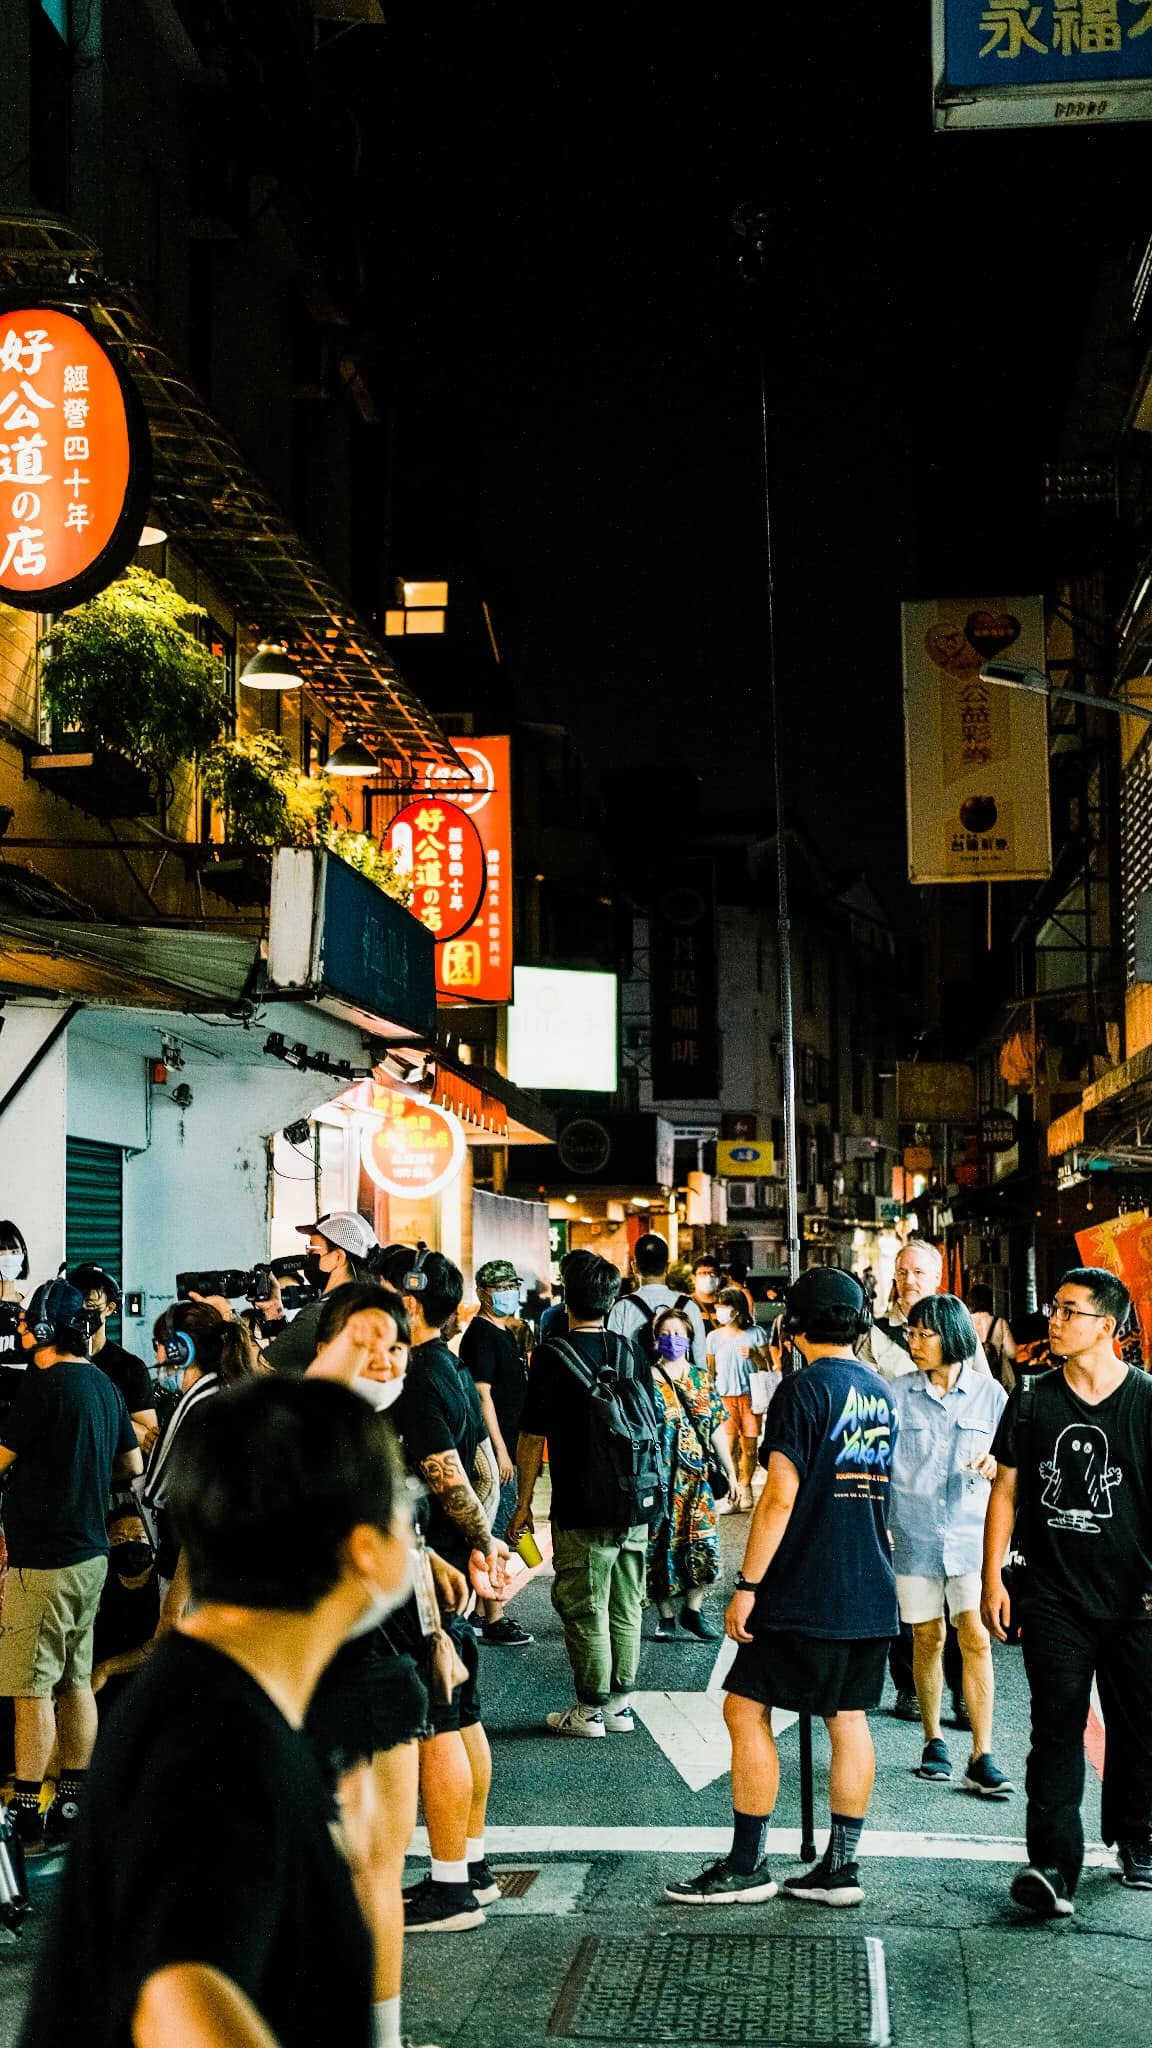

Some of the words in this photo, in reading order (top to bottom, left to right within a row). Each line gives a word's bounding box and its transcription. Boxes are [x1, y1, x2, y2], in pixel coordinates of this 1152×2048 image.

[63, 364, 91, 534] 經營四十年
[413, 807, 446, 933] 好公道の店
